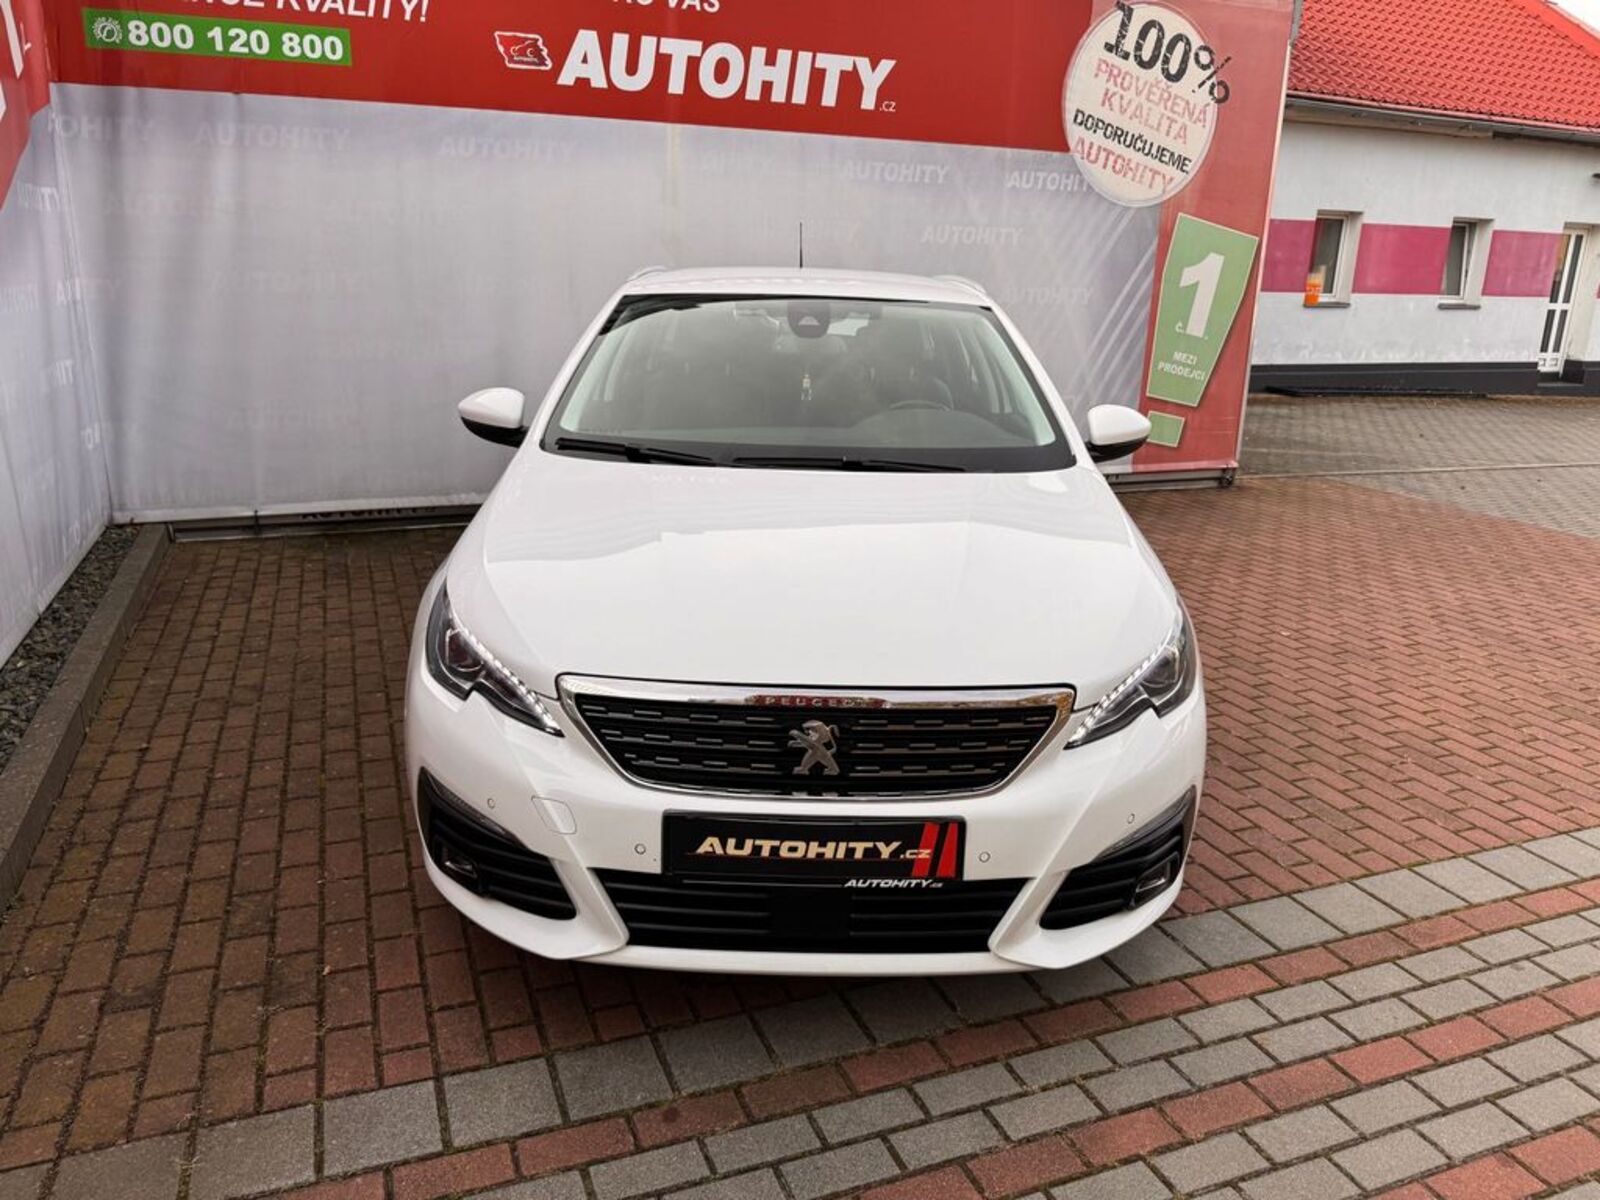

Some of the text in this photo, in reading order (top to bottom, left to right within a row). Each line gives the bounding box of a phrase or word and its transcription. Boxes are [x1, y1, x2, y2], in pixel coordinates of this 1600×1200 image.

[127, 20, 344, 61] 800 120 800
[1104, 0, 1232, 104] 100%
[1094, 58, 1210, 128] PROVĚŘENÁ
[1101, 88, 1188, 144] KVALITA
[1073, 108, 1192, 175] DOPORUČUJEME
[841, 158, 949, 185] AUTOHITY
[1074, 136, 1174, 196] AUTOHITY
[920, 223, 1024, 248] AUTOHITY
[1158, 361, 1206, 380] PRODEJCI
[1173, 351, 1198, 365] MEZI
